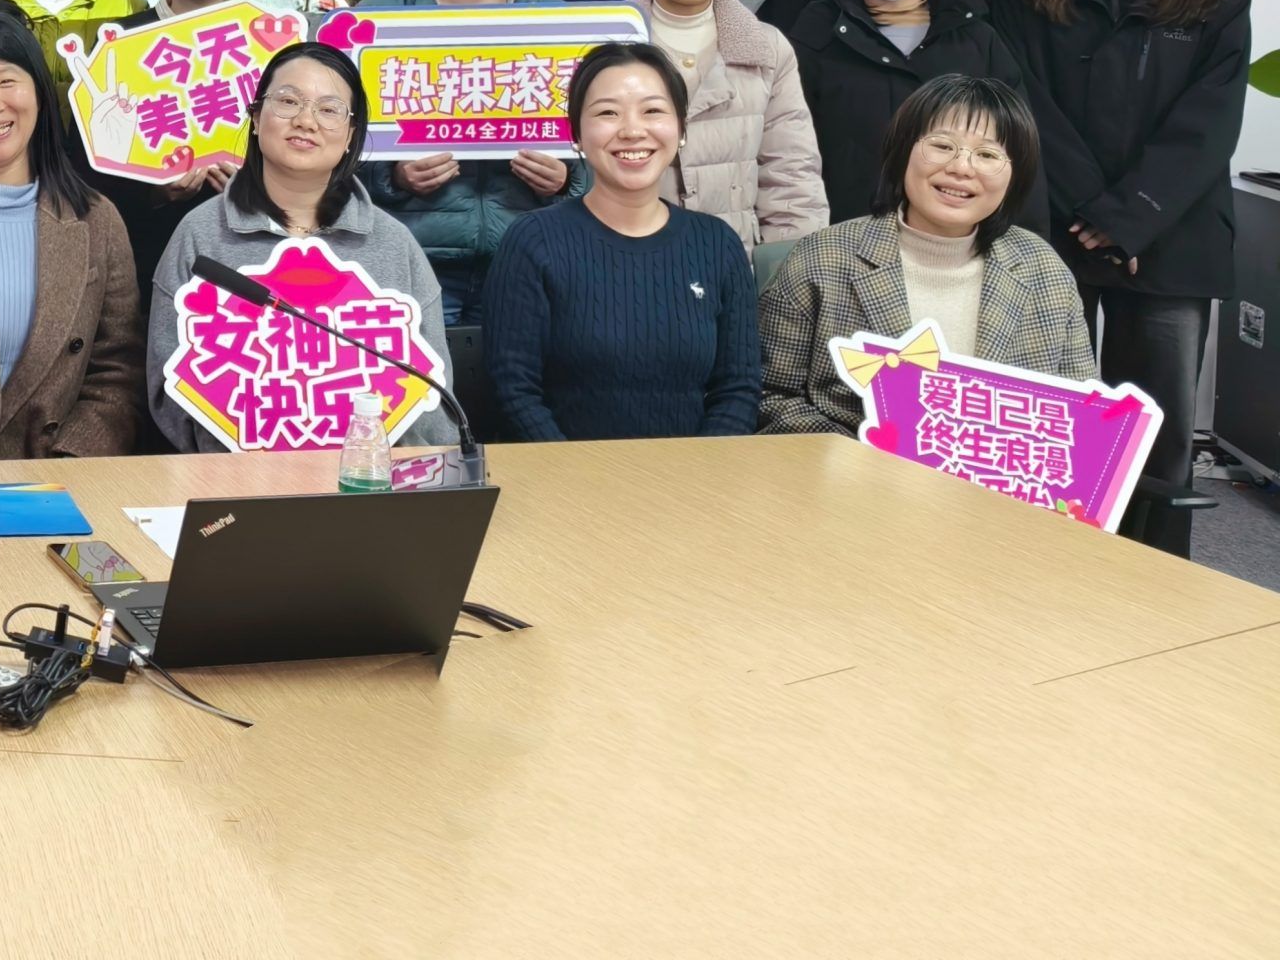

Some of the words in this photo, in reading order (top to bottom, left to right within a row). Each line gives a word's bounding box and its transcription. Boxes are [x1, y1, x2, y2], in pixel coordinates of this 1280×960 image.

[143, 22, 252, 84] 今天
[425, 121, 561, 140] 2024全力以赴
[192, 304, 406, 385] 女神节
[232, 372, 357, 444] 快乐
[920, 373, 1075, 446] 爱自己是
[917, 414, 1075, 488] 终生浪漫
[199, 512, 236, 538] ThinkPad
